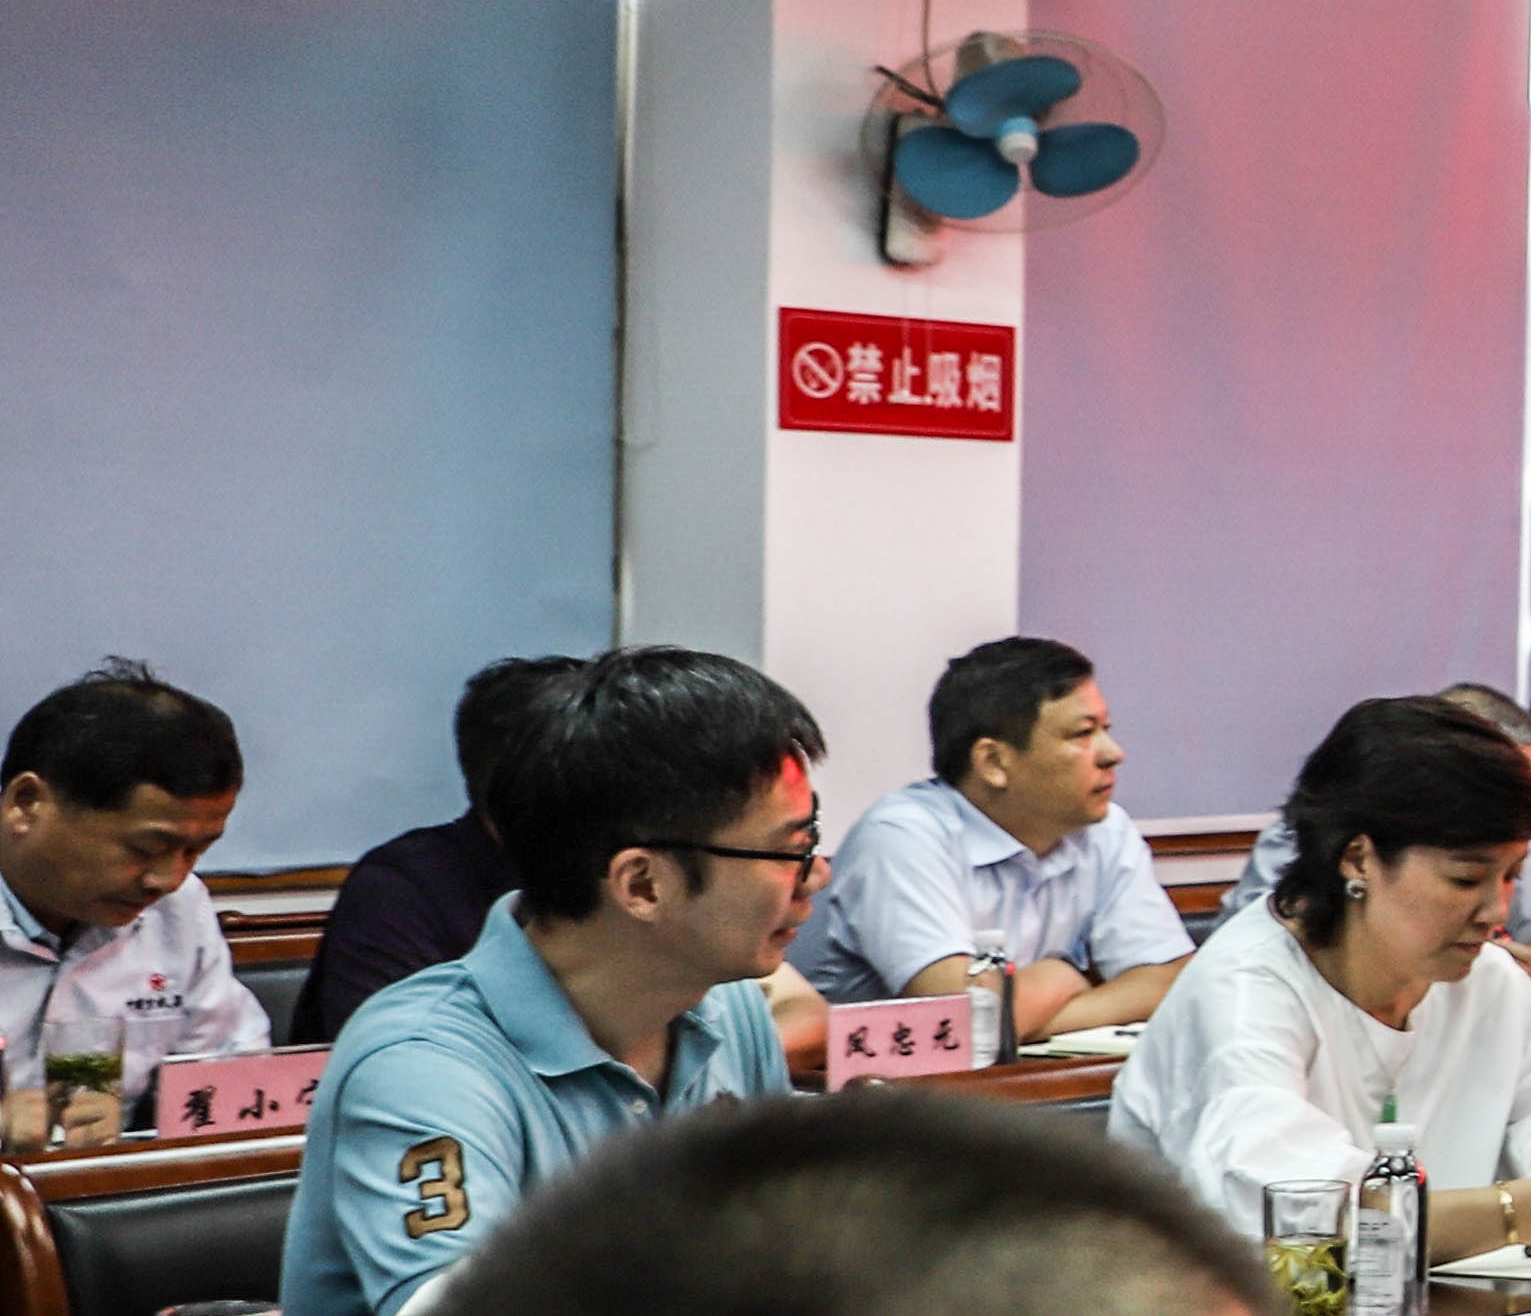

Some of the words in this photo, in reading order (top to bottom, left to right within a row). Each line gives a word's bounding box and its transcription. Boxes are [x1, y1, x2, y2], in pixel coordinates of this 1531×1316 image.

[846, 341, 1002, 412] 禁止吸烟
[398, 1135, 471, 1240] 3
